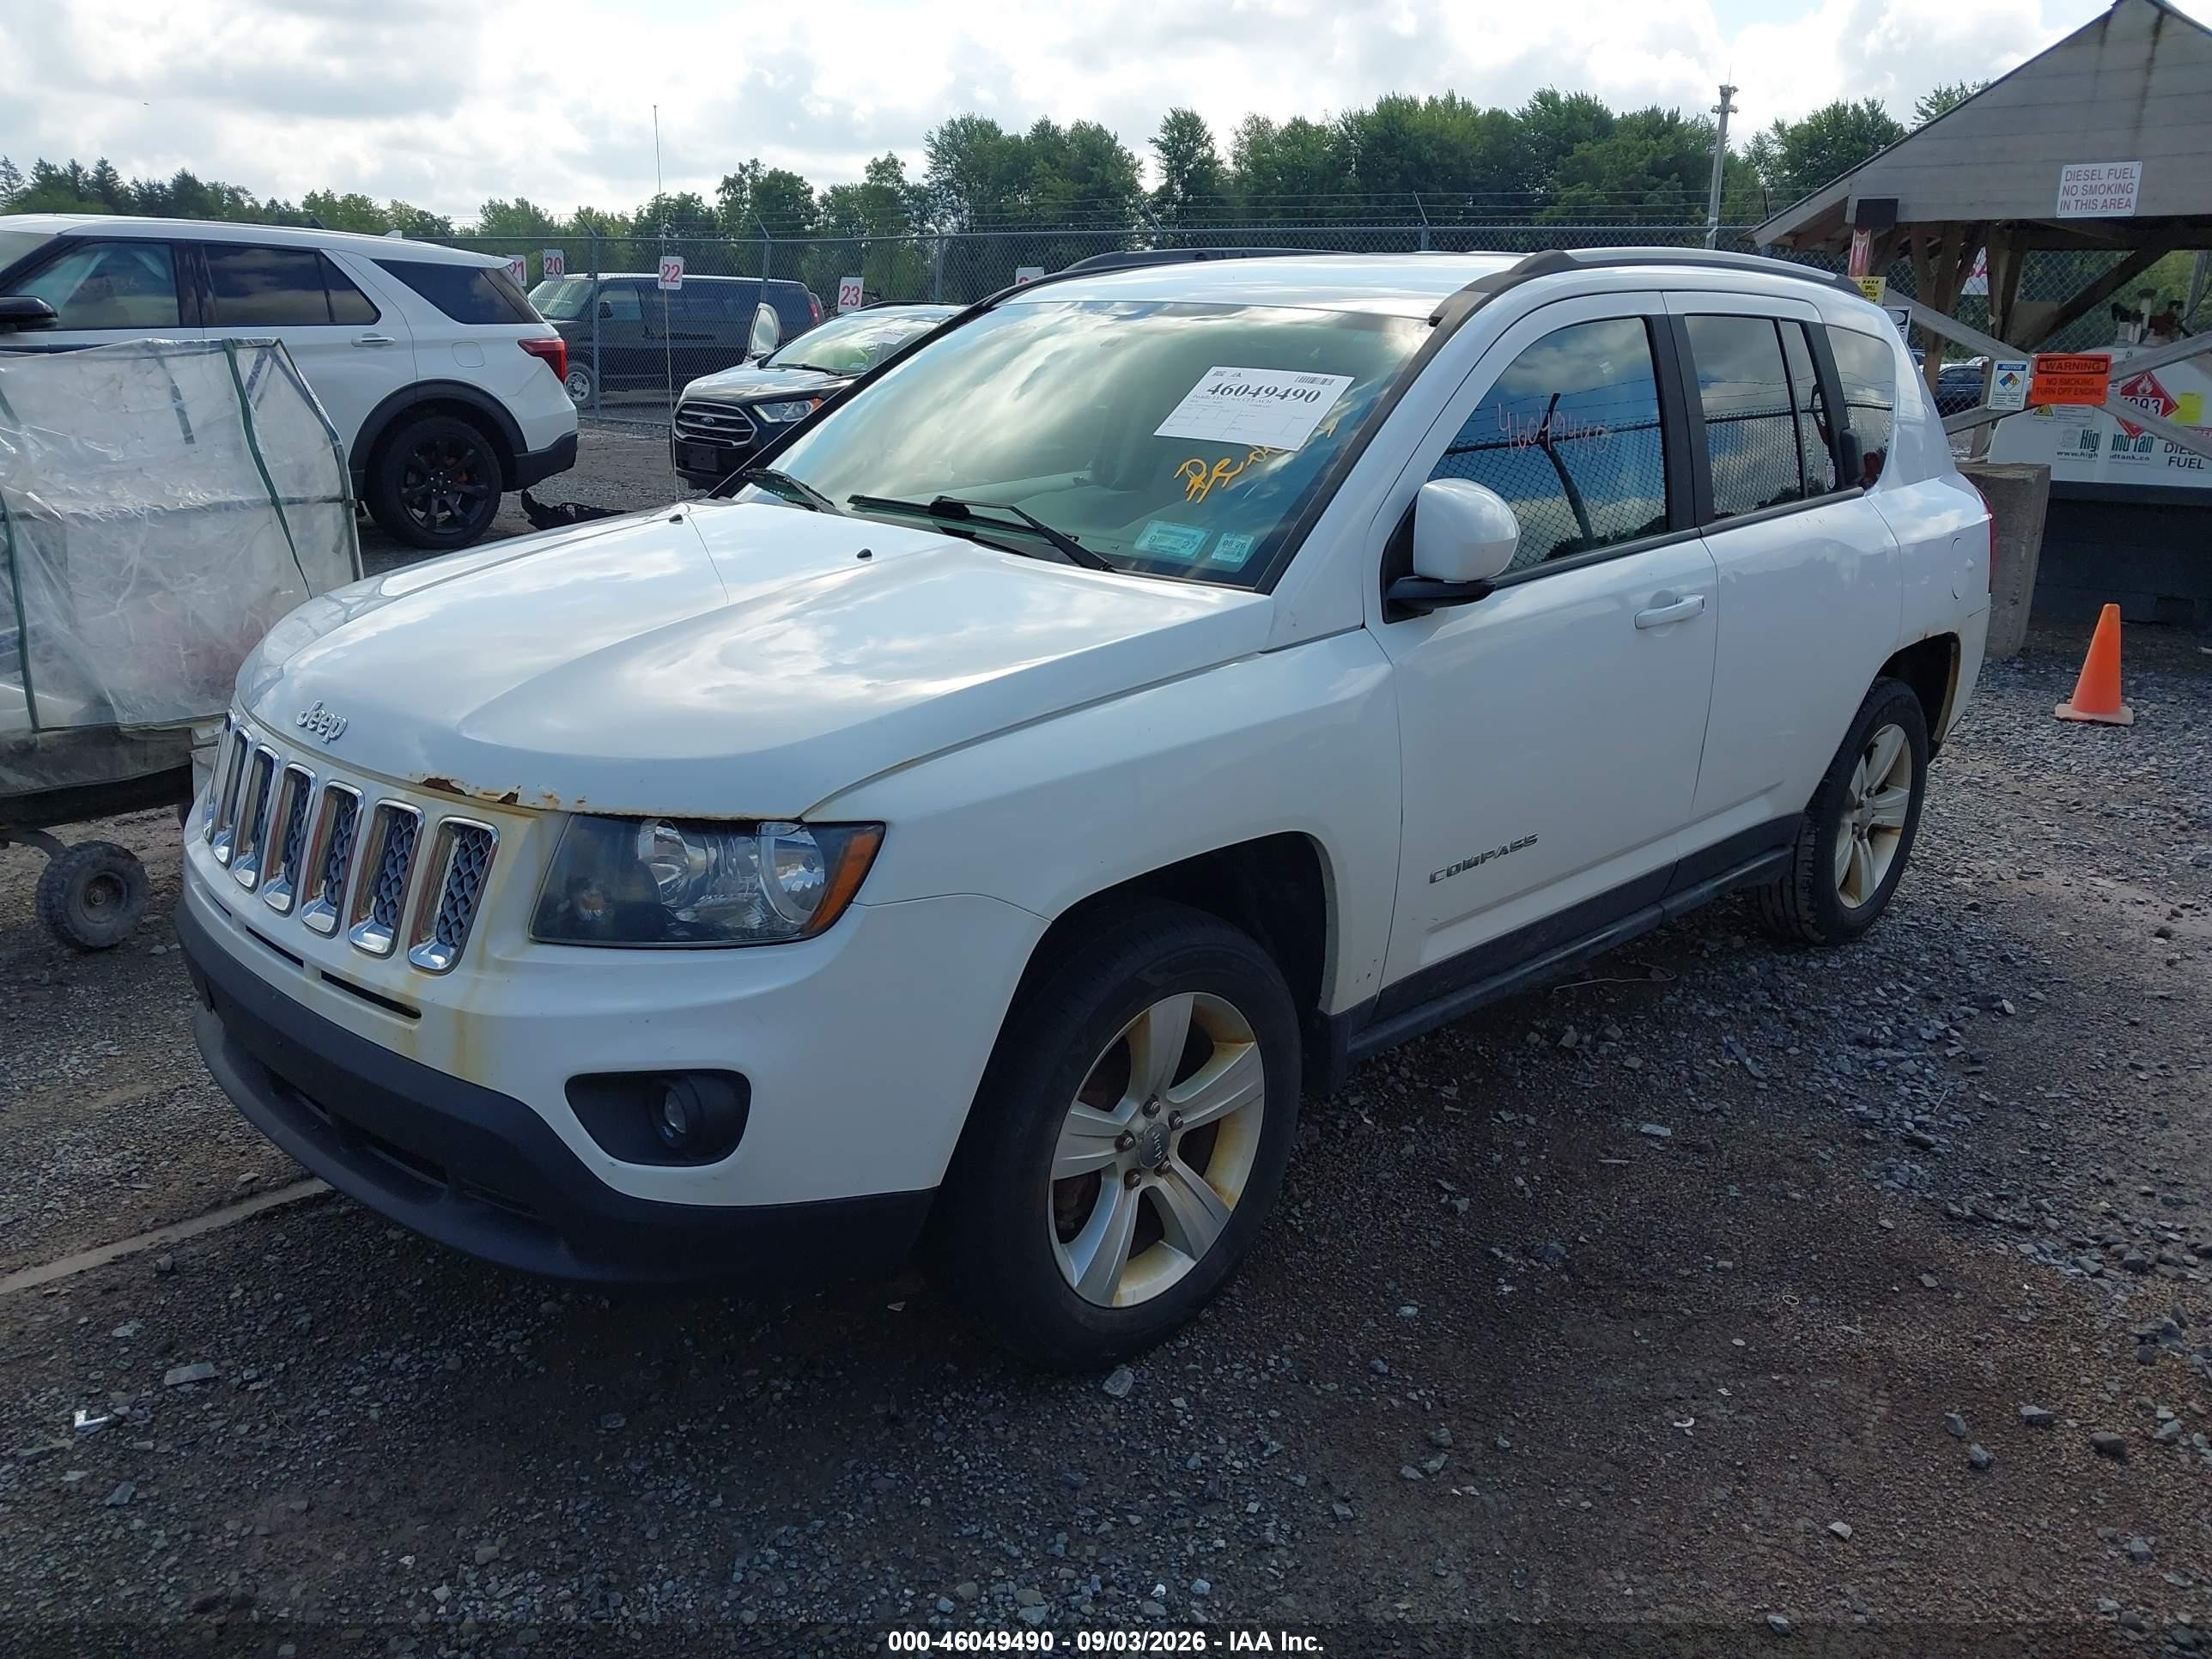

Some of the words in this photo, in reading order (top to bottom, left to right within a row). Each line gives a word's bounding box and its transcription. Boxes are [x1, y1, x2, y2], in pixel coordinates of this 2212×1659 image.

[2065, 169, 2103, 182] DIESEL
[2107, 167, 2136, 180] FUEL
[2062, 185, 2078, 196] NO
[2081, 182, 2135, 196] SMOKING
[2059, 199, 2070, 211] IN
[2075, 198, 2099, 210] THIS
[2100, 198, 2132, 210] AREA
[545, 257, 562, 275] 20
[659, 264, 680, 283] 22
[841, 285, 860, 306] 23
[2045, 361, 2101, 371] WARNING
[1206, 382, 1322, 404] 46049490
[2073, 387, 2103, 396] ENGINE
[2168, 456, 2205, 470] FUEL
[296, 701, 348, 744] Jeep
[1429, 832, 1539, 884] COMPASS
